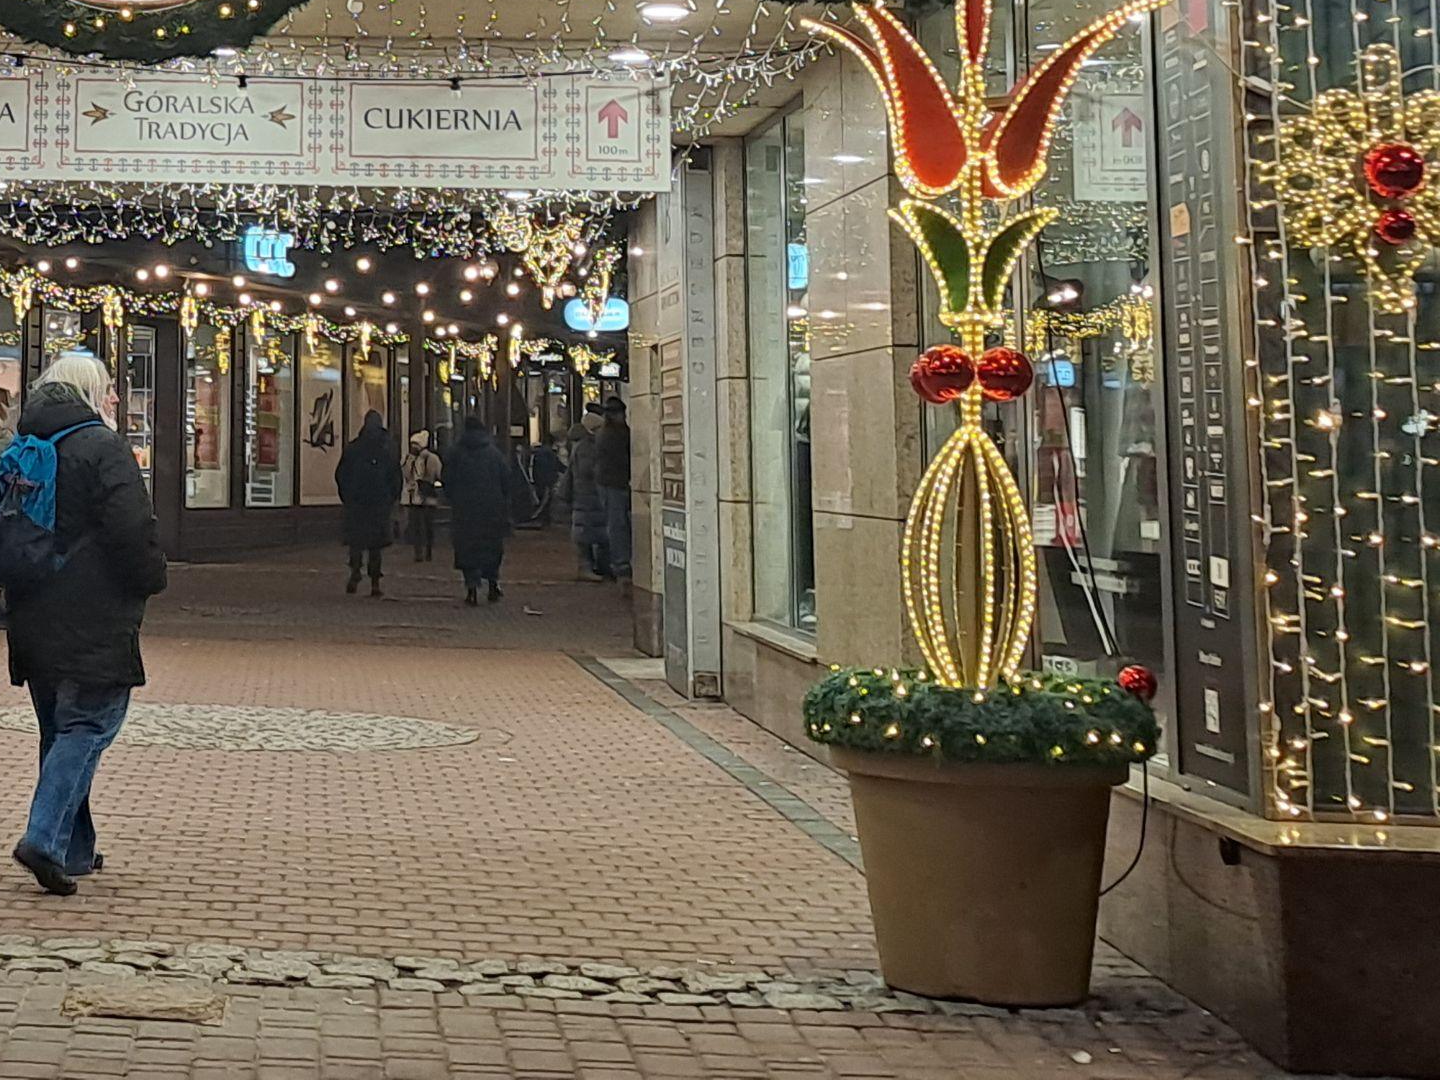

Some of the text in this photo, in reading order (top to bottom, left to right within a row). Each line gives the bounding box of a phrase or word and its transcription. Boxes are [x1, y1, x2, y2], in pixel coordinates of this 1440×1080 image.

[123, 90, 256, 116] GÓRALSKA
[137, 117, 249, 147] TRADYCJA
[363, 107, 523, 132] CUKIERNIA
